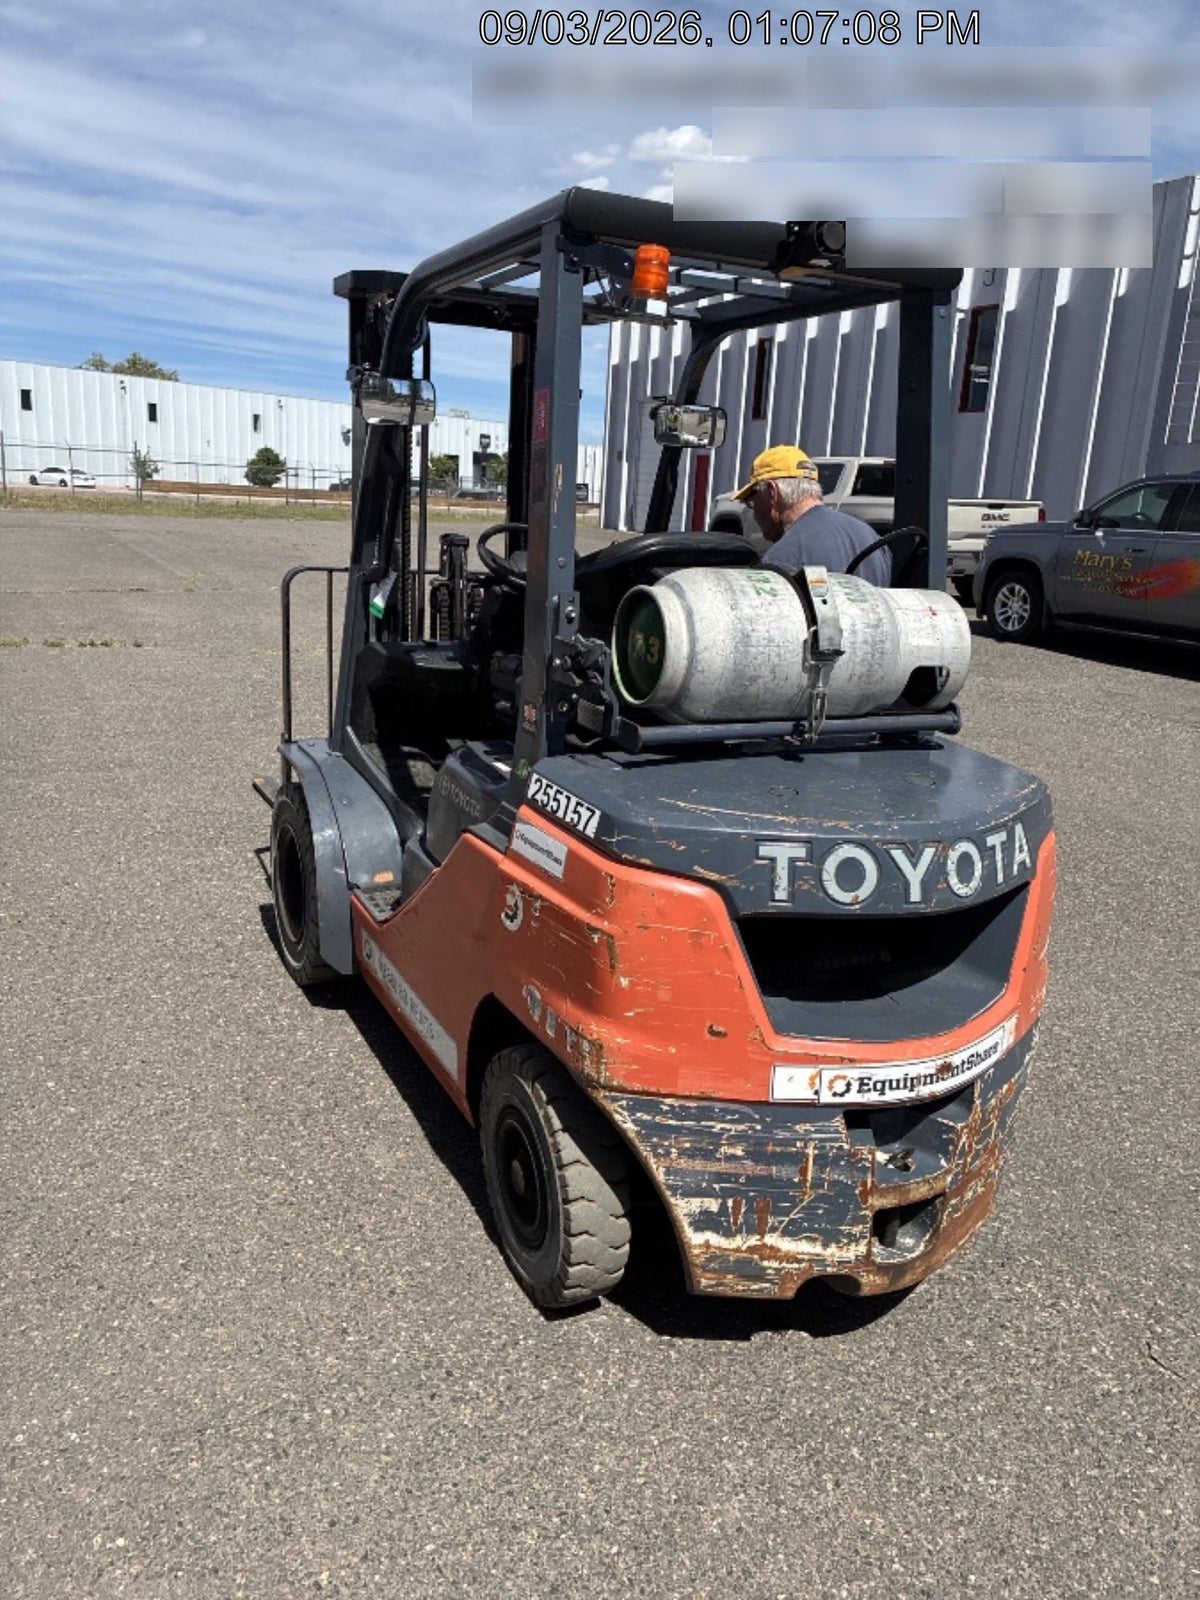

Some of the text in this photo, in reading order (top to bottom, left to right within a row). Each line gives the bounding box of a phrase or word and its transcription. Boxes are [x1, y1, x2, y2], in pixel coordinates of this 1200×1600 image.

[981, 513, 1010, 521] GMC
[1073, 549, 1134, 569] Mary's
[531, 777, 597, 833] 255157
[757, 822, 1032, 904] TOYOTA
